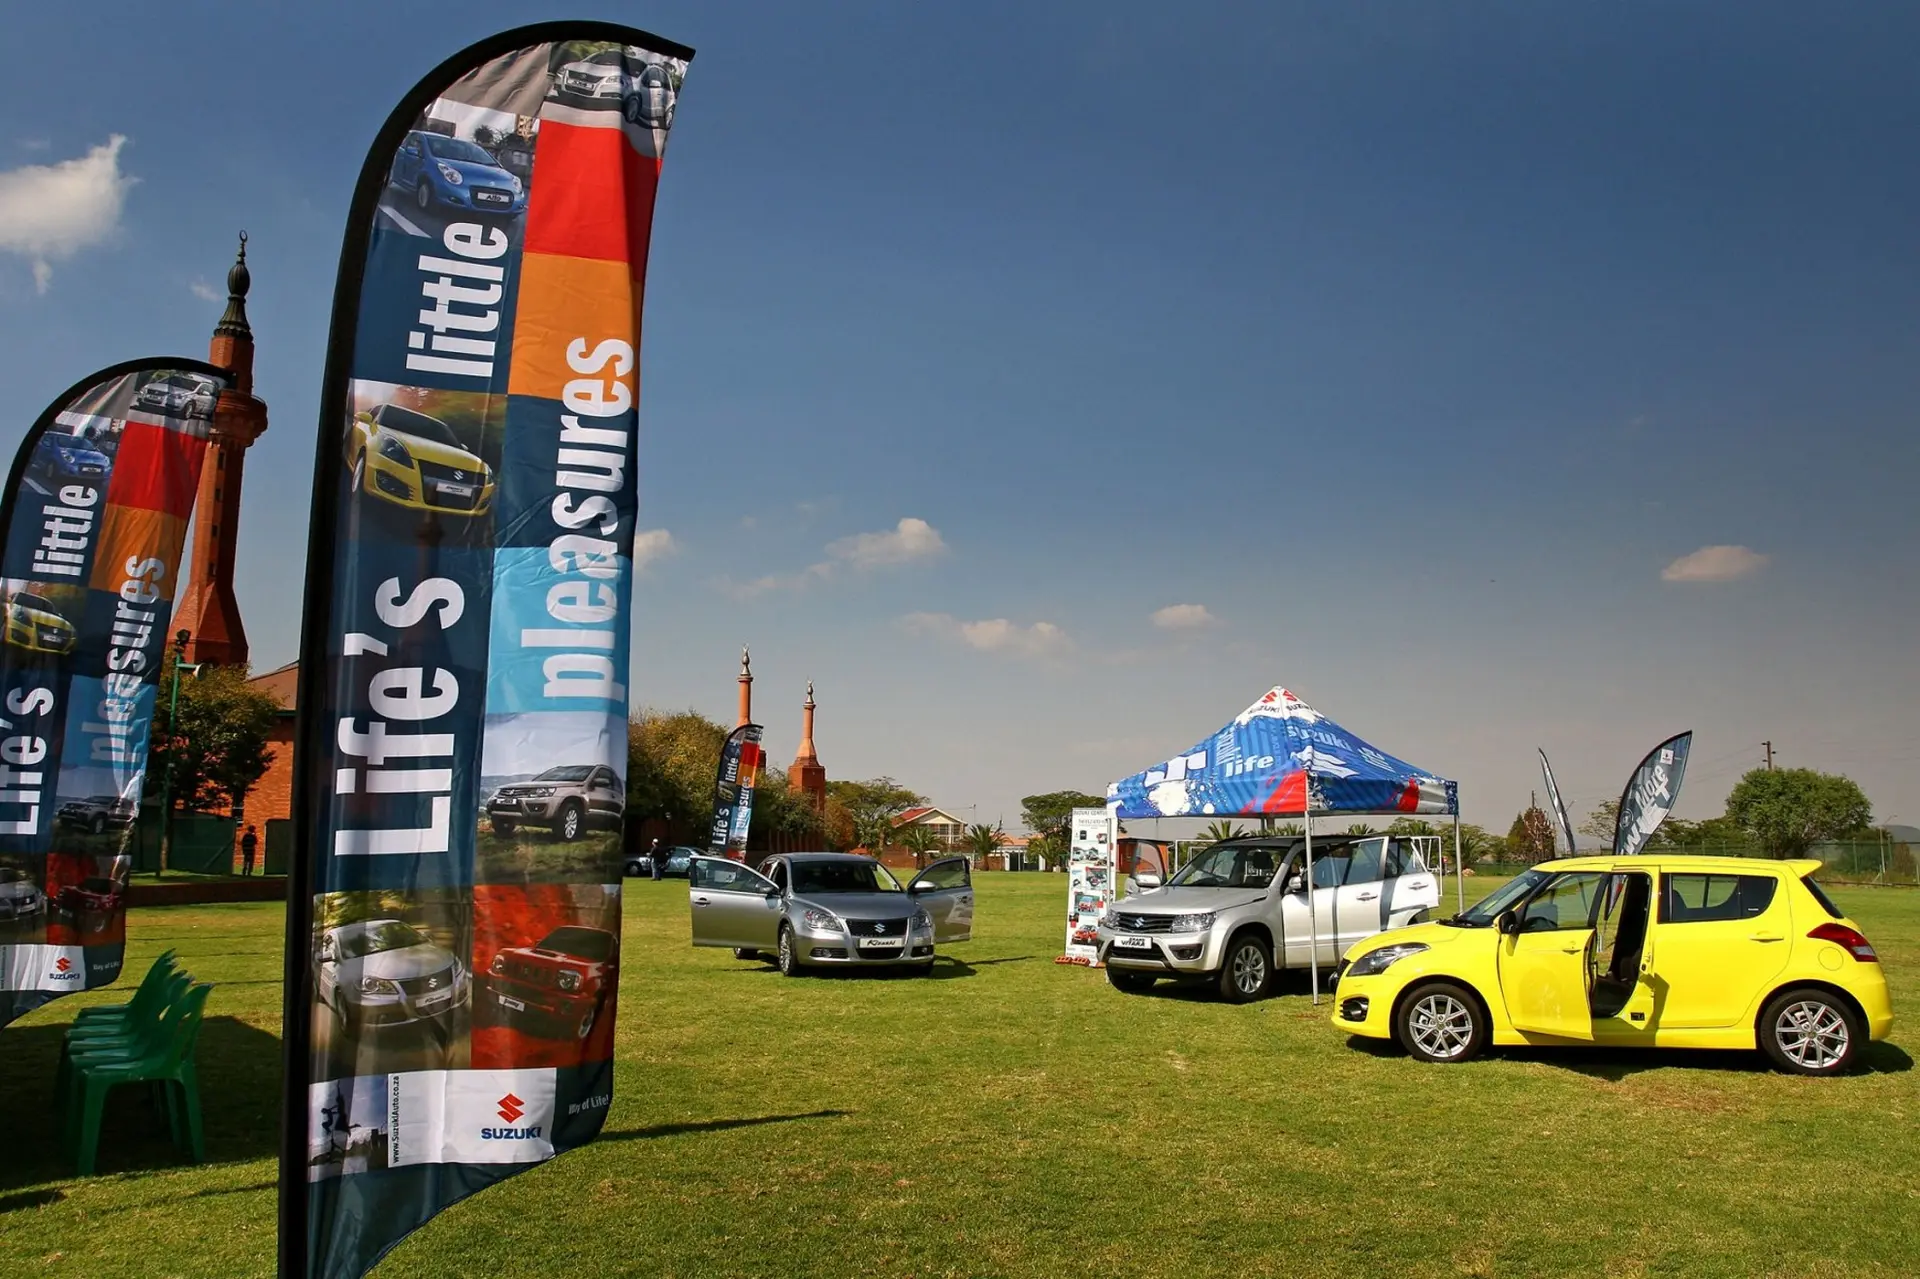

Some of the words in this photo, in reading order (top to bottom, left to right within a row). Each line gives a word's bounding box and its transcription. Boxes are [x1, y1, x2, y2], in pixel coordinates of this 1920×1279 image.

[406, 221, 509, 377] little
[32, 484, 98, 576] little
[521, 337, 634, 703] pleasures
[81, 555, 165, 762] pleasures
[335, 576, 465, 856] Life's
[725, 757, 739, 782] little
[1225, 755, 1274, 778] life
[1636, 765, 1666, 809] More
[712, 807, 730, 845] Life's
[481, 1126, 542, 1140] SUZUKI
